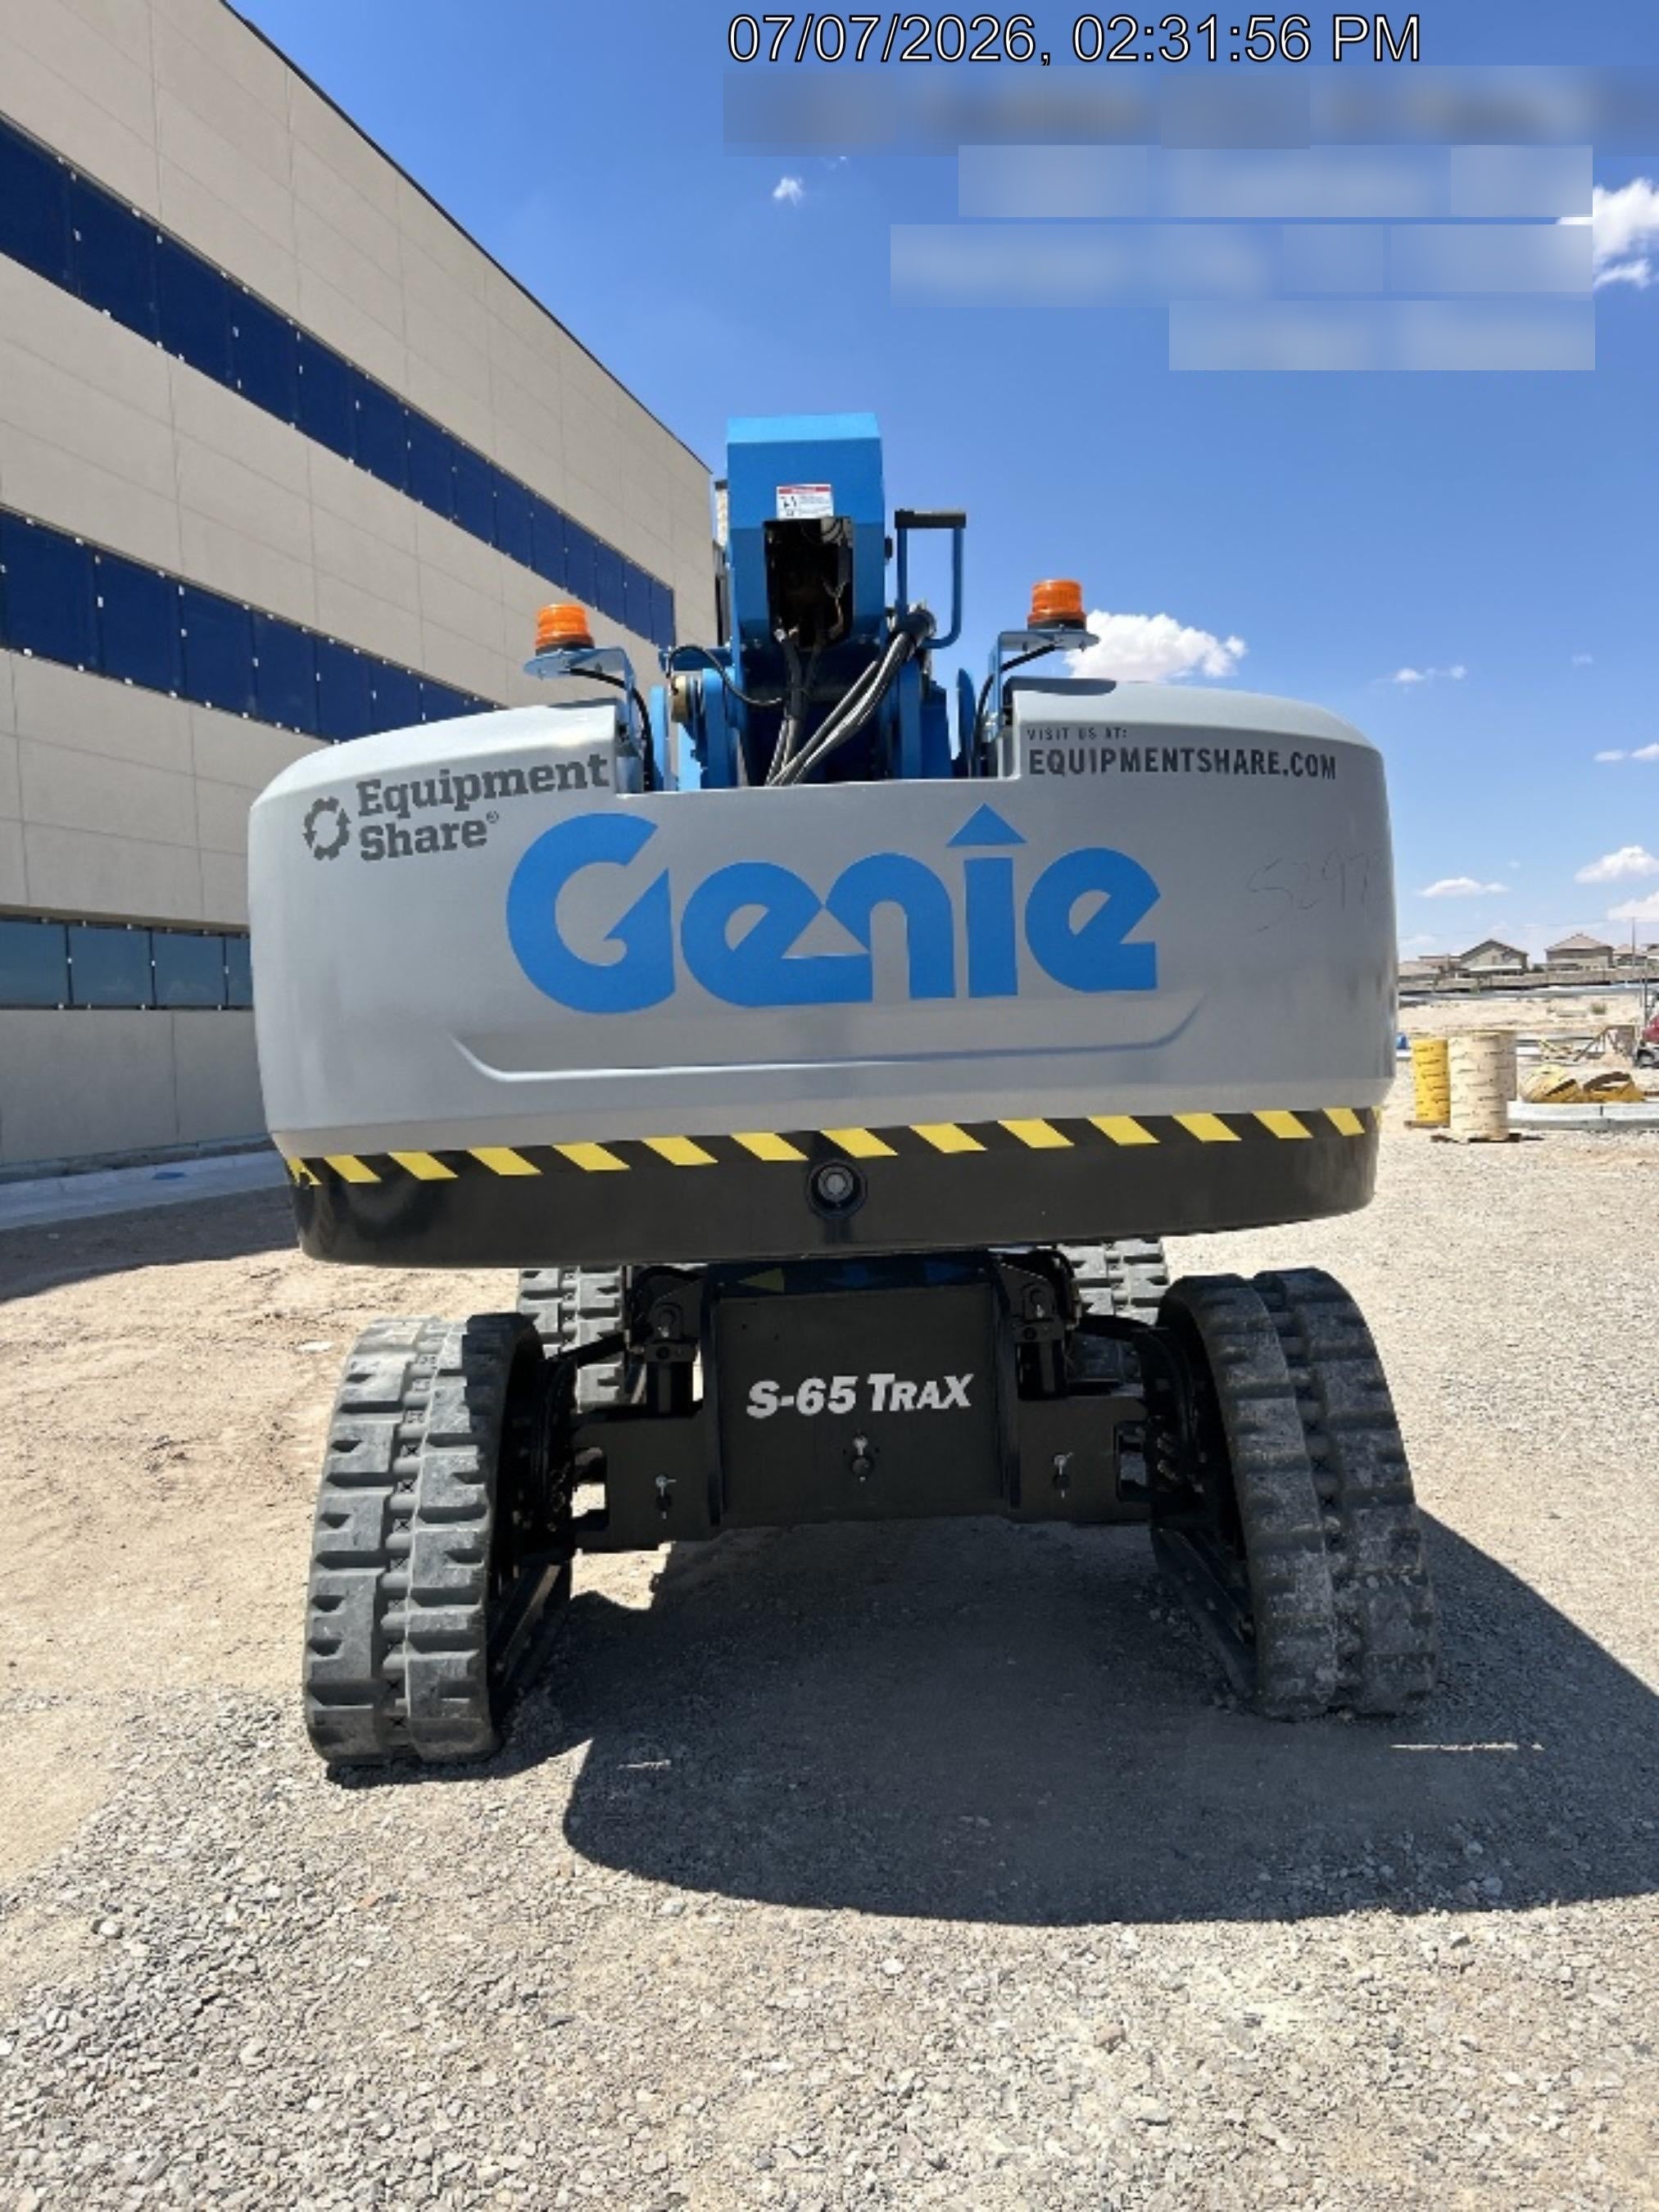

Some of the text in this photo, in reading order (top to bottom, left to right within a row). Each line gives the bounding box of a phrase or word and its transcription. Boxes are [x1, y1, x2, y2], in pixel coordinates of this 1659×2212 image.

[1027, 727, 1069, 741] VISIT
[1078, 727, 1097, 740] US
[1029, 746, 1337, 780] EQUIPMENTSHARE.COM
[356, 754, 610, 818] Equipment
[505, 803, 1162, 1014] Genie
[746, 1376, 859, 1419] S-65
